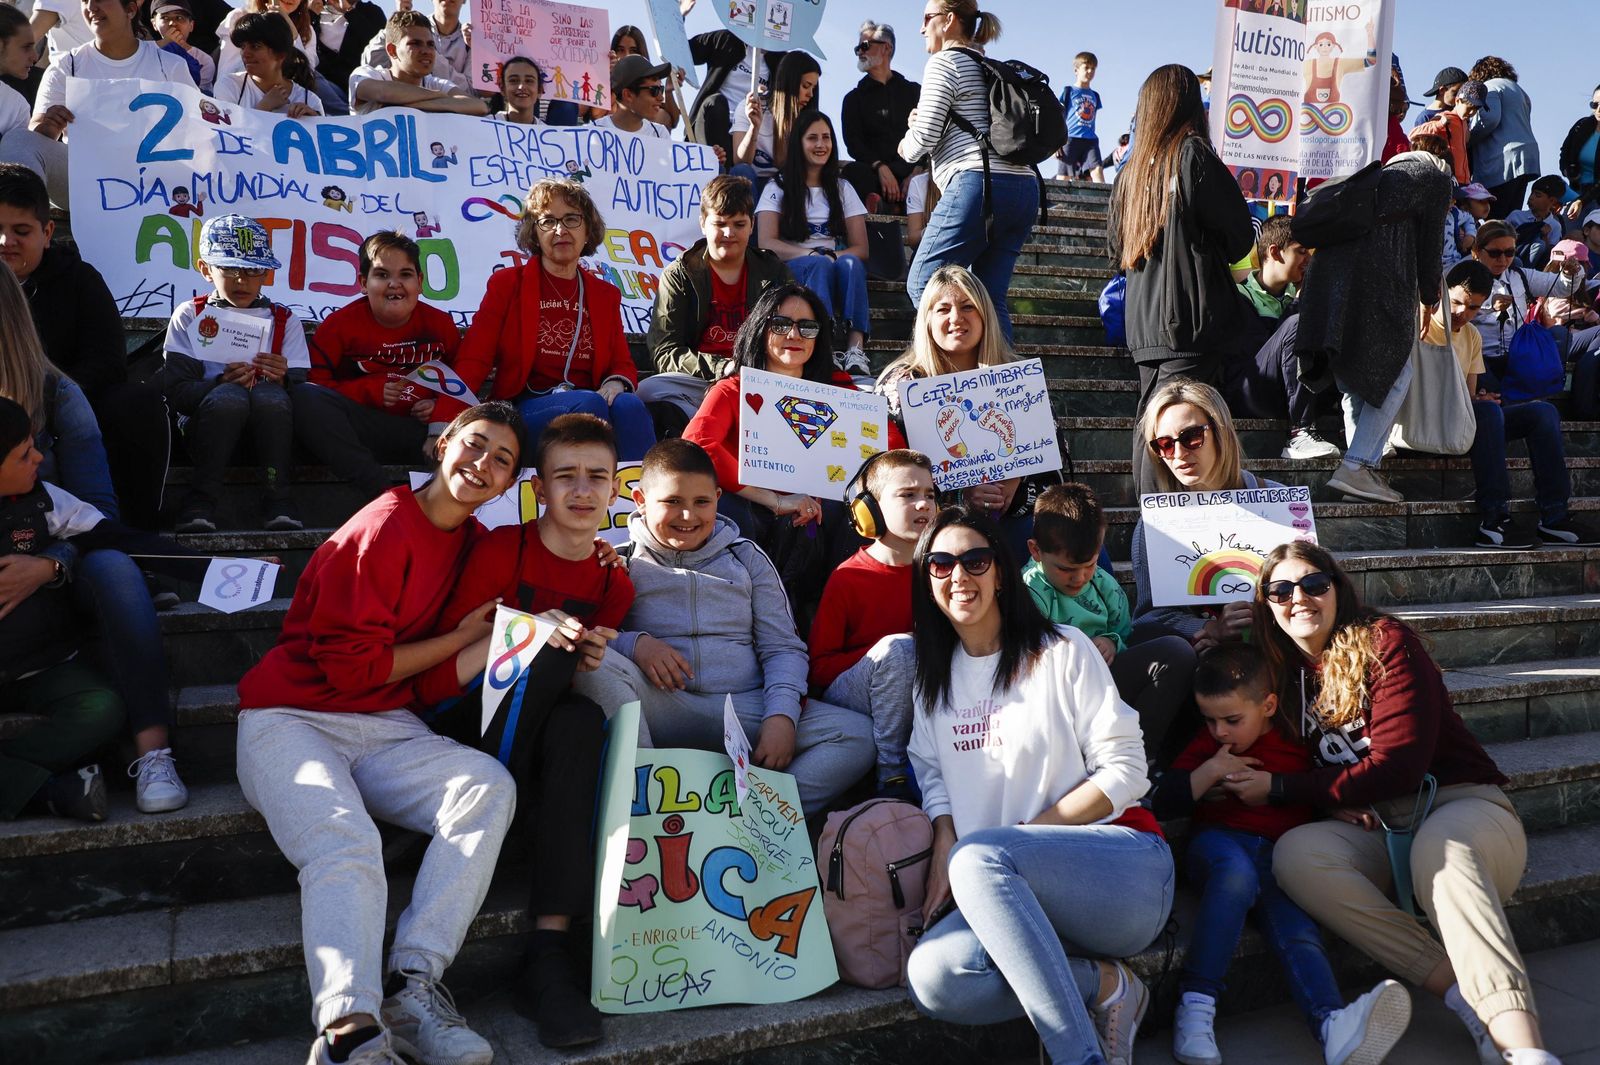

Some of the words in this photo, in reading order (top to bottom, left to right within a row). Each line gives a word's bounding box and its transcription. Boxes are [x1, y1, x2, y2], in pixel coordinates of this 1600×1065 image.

[519, 4, 530, 16] LA
[552, 12, 571, 25] SINO
[580, 17, 594, 28] LAS
[492, 40, 516, 55] VIDA
[588, 40, 597, 48] LA
[551, 45, 599, 64] SOCIEDAD
[1269, 67, 1292, 76] Mundial
[128, 93, 194, 163] 2
[211, 128, 254, 156] DE
[272, 114, 448, 182] ABRIL
[480, 119, 645, 176] TRASTORNO
[672, 143, 714, 174] DEL
[1256, 154, 1279, 163] NIEVES
[1311, 160, 1320, 168] DE
[1321, 160, 1334, 168] LAS
[1335, 160, 1359, 168] NIEVES
[1300, 168, 1334, 177] (Granada)
[96, 167, 171, 211] DÍA
[360, 192, 416, 215] DEL
[612, 177, 700, 220] AUTISTA
[953, 376, 978, 394] LAS
[744, 444, 769, 456] ERES
[1016, 444, 1032, 455] DE
[1033, 438, 1053, 451] LAS
[744, 459, 796, 474] AUTENTICO
[956, 471, 969, 481] ES
[970, 467, 987, 478] QUE
[989, 464, 1003, 476] NO
[944, 479, 967, 491] DOS
[968, 473, 1006, 487] IGUALES
[1198, 491, 1234, 506] LAS
[1236, 488, 1310, 504] MIMBRES
[747, 772, 805, 826] CARMEN
[632, 925, 701, 947] ENRIQUE
[624, 969, 716, 1006] LUCAS
